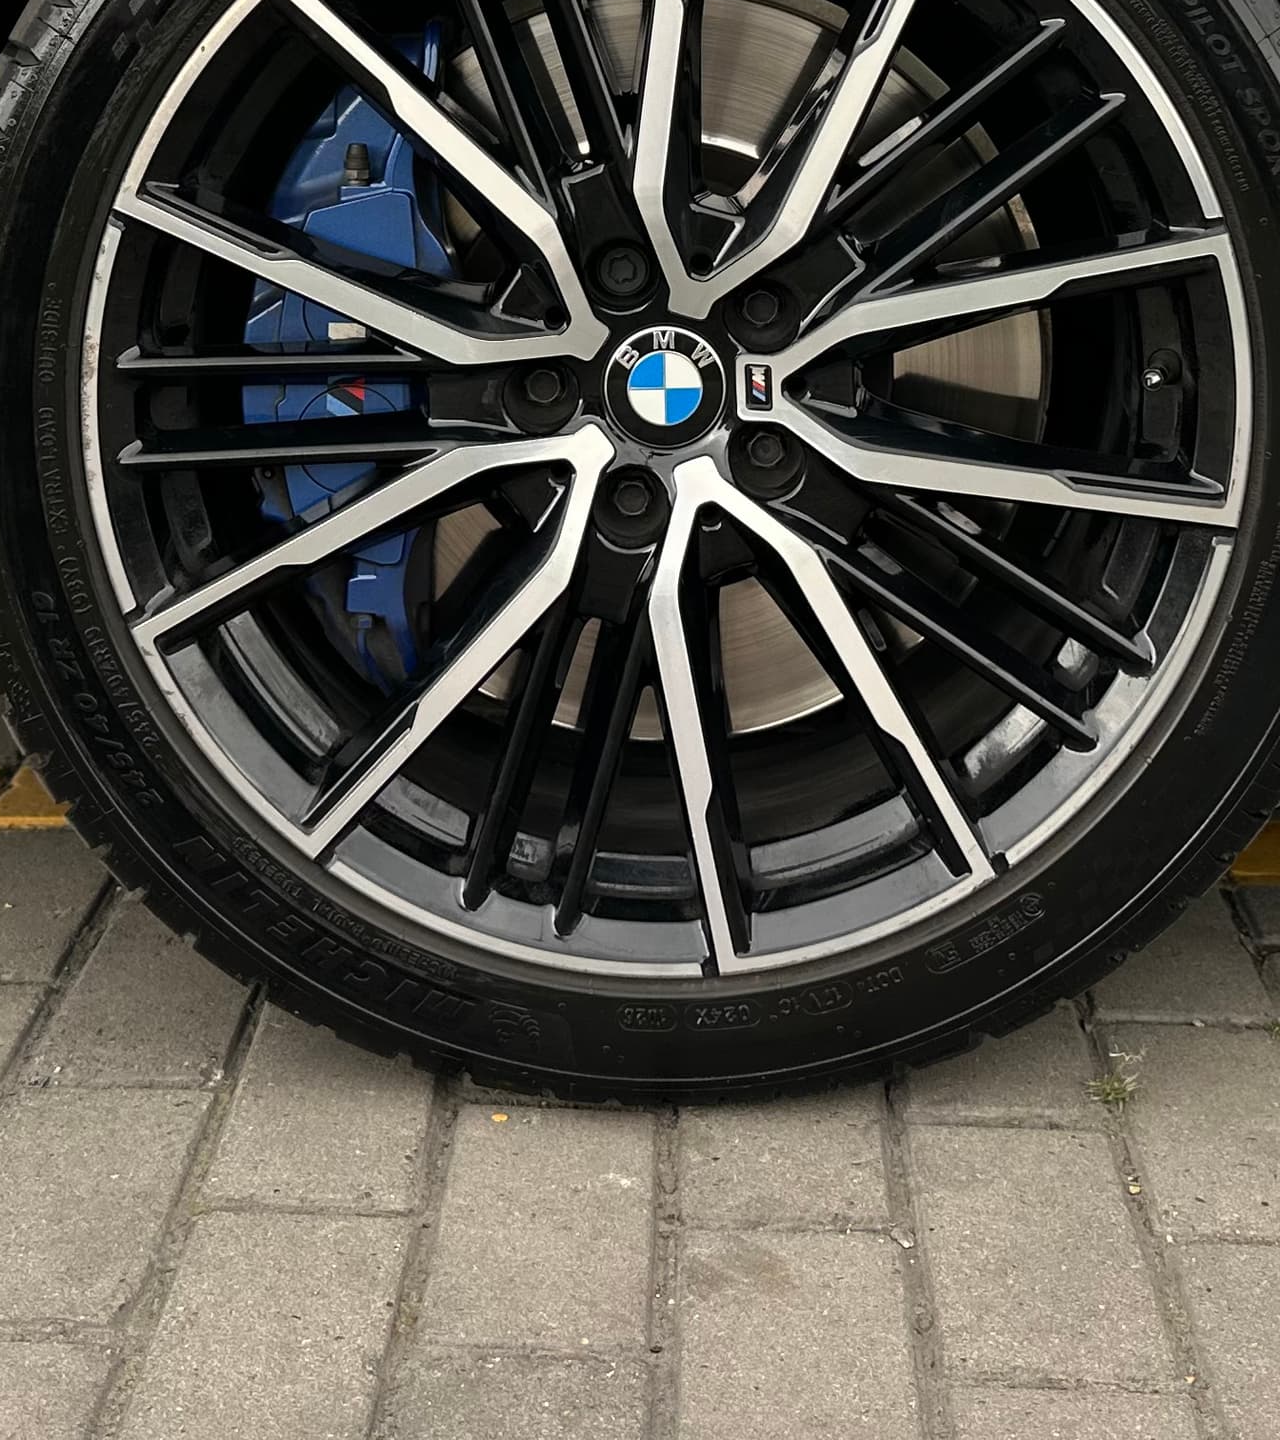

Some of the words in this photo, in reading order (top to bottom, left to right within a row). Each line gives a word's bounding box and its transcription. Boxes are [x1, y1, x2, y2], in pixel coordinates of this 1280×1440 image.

[615, 331, 714, 370] BMW
[36, 406, 59, 461] LOAD
[39, 466, 71, 535] EXTRA
[73, 689, 165, 810] 245/40
[173, 833, 476, 1023] MICHELIN
